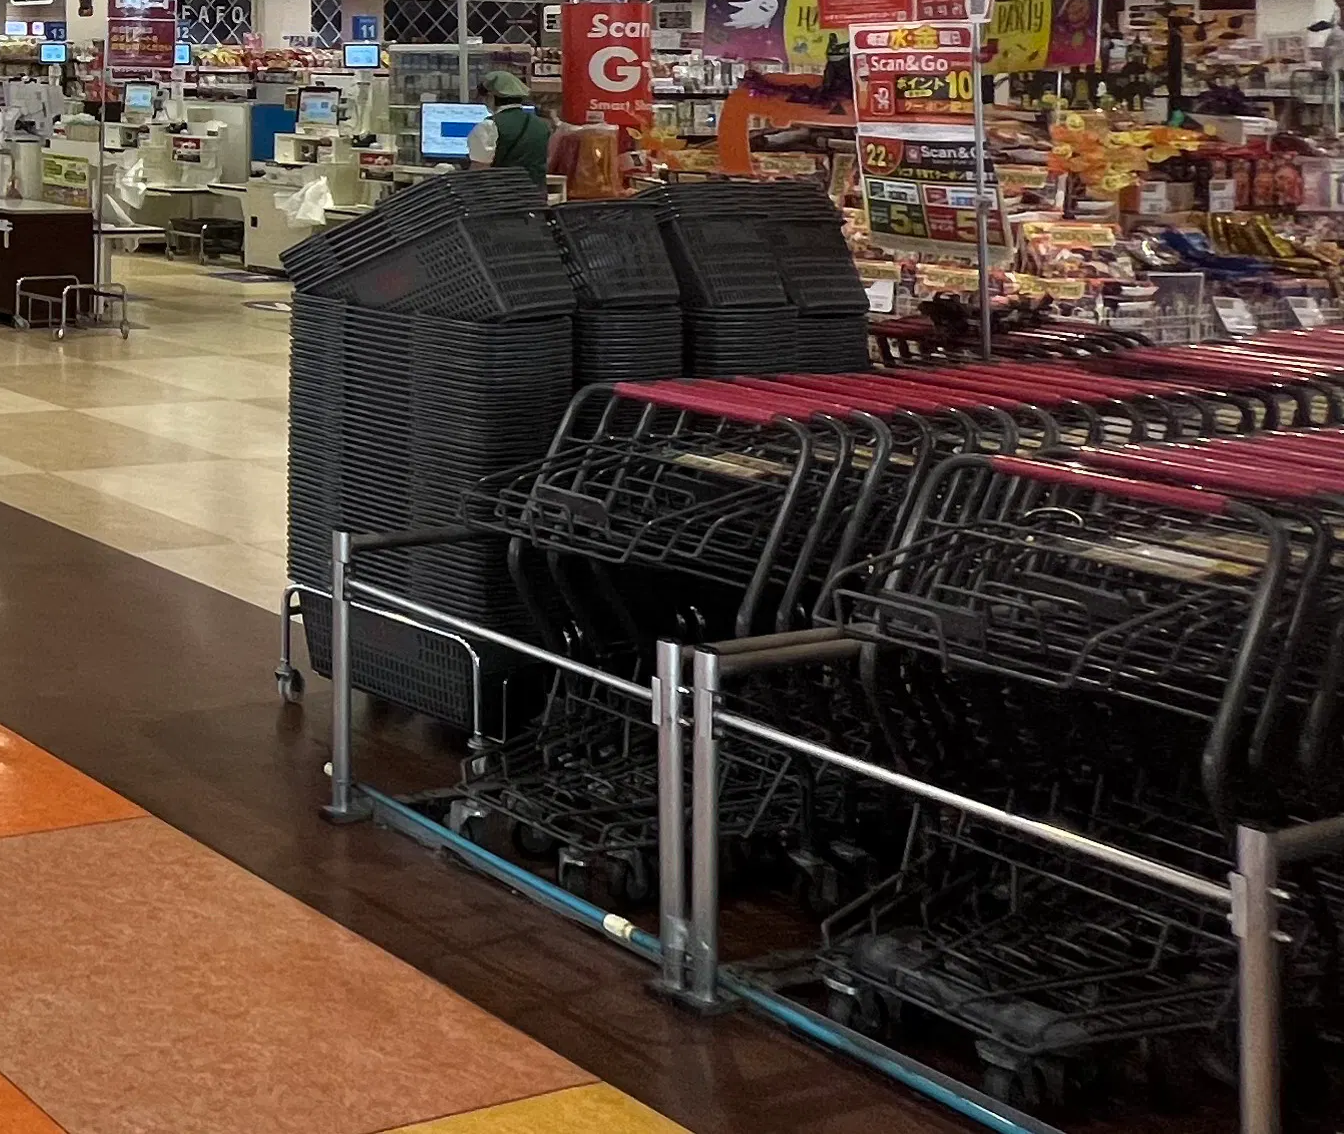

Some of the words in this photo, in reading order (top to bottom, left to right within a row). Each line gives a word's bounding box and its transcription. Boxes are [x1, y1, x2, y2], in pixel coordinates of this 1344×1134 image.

[587, 13, 651, 38] Scan
[997, 0, 1044, 34] PARTY
[51, 28, 65, 40] 13
[361, 24, 375, 38] 11
[870, 54, 948, 72] Scan&Go
[945, 70, 973, 100] 10
[589, 98, 630, 111] Smart
[866, 143, 887, 167] 22
